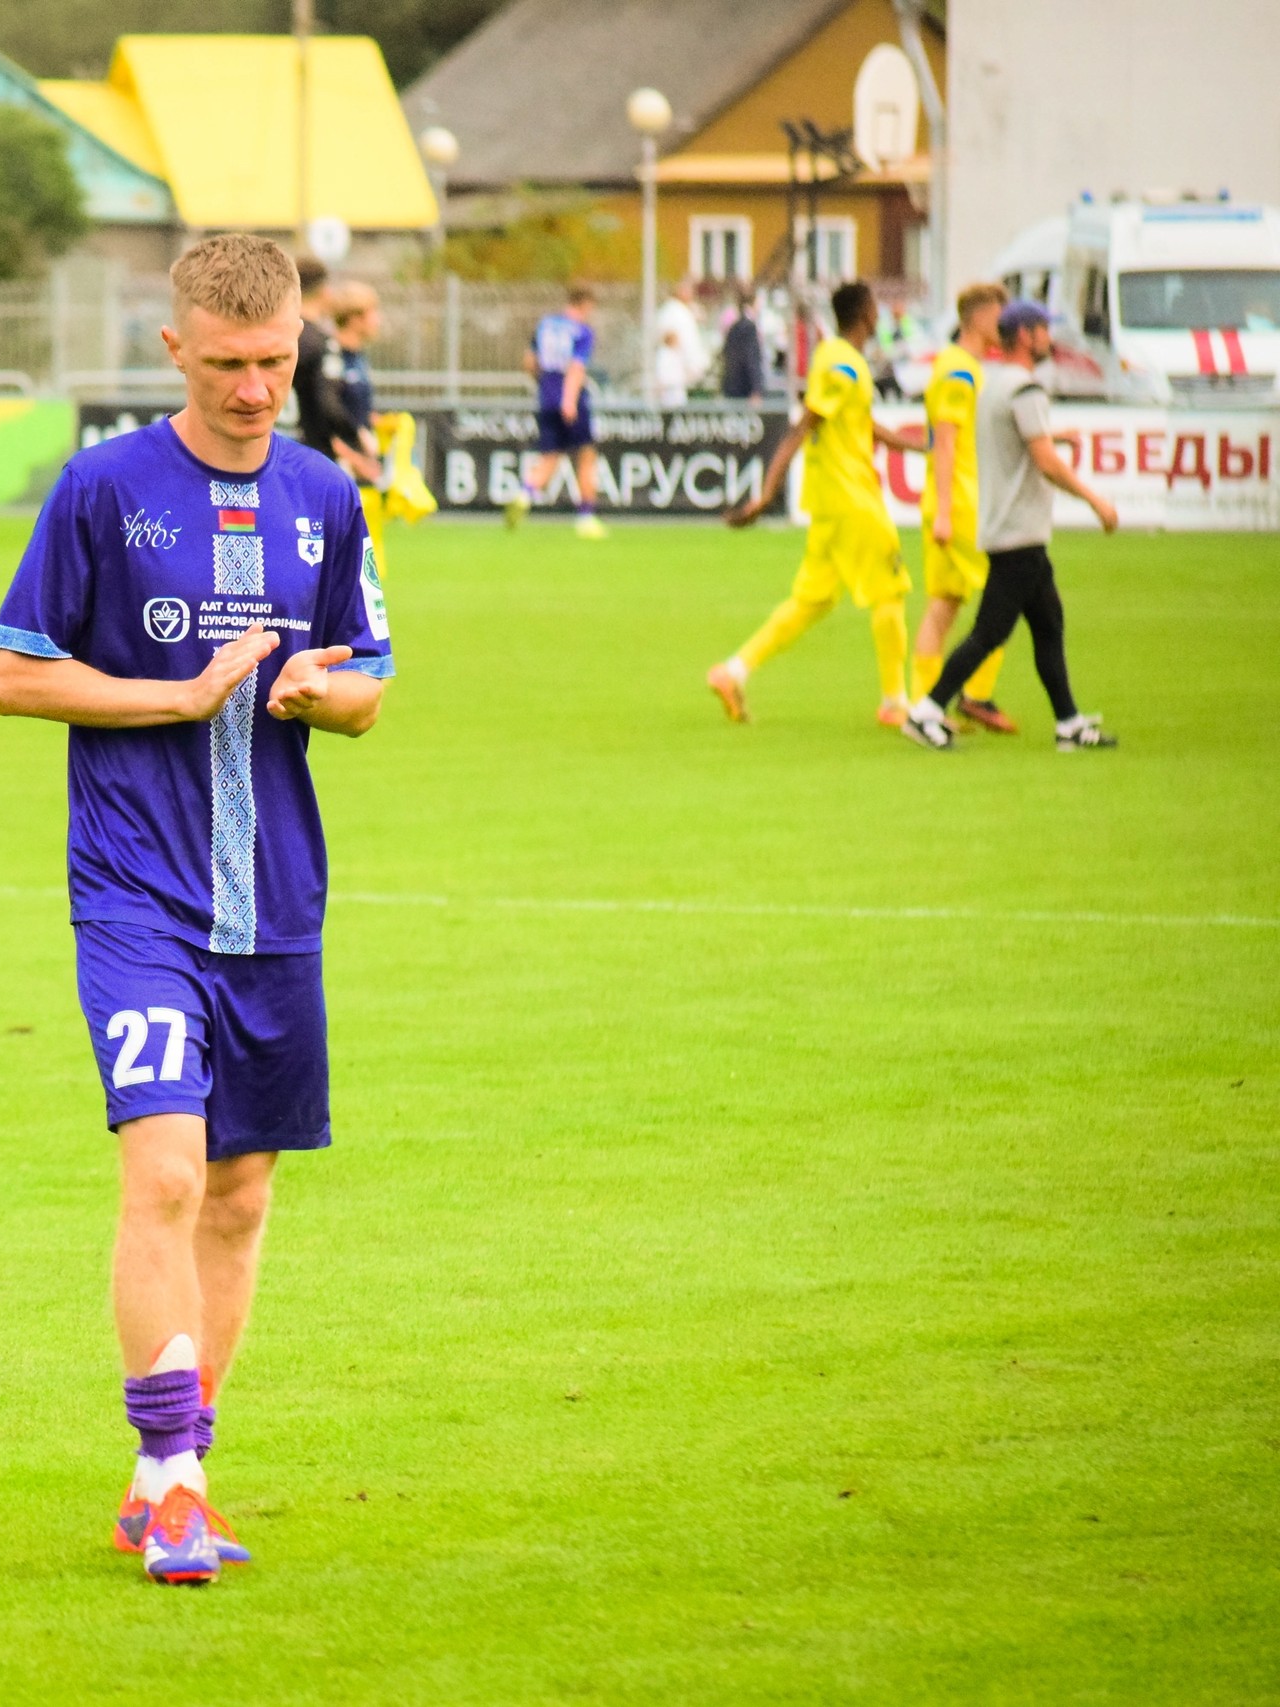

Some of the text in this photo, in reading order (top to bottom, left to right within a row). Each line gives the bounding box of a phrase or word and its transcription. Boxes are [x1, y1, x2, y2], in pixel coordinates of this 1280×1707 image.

[446, 449, 478, 504] В
[126, 526, 182, 549] 1005
[199, 600, 223, 612] ААТ
[107, 1006, 188, 1089] 27
